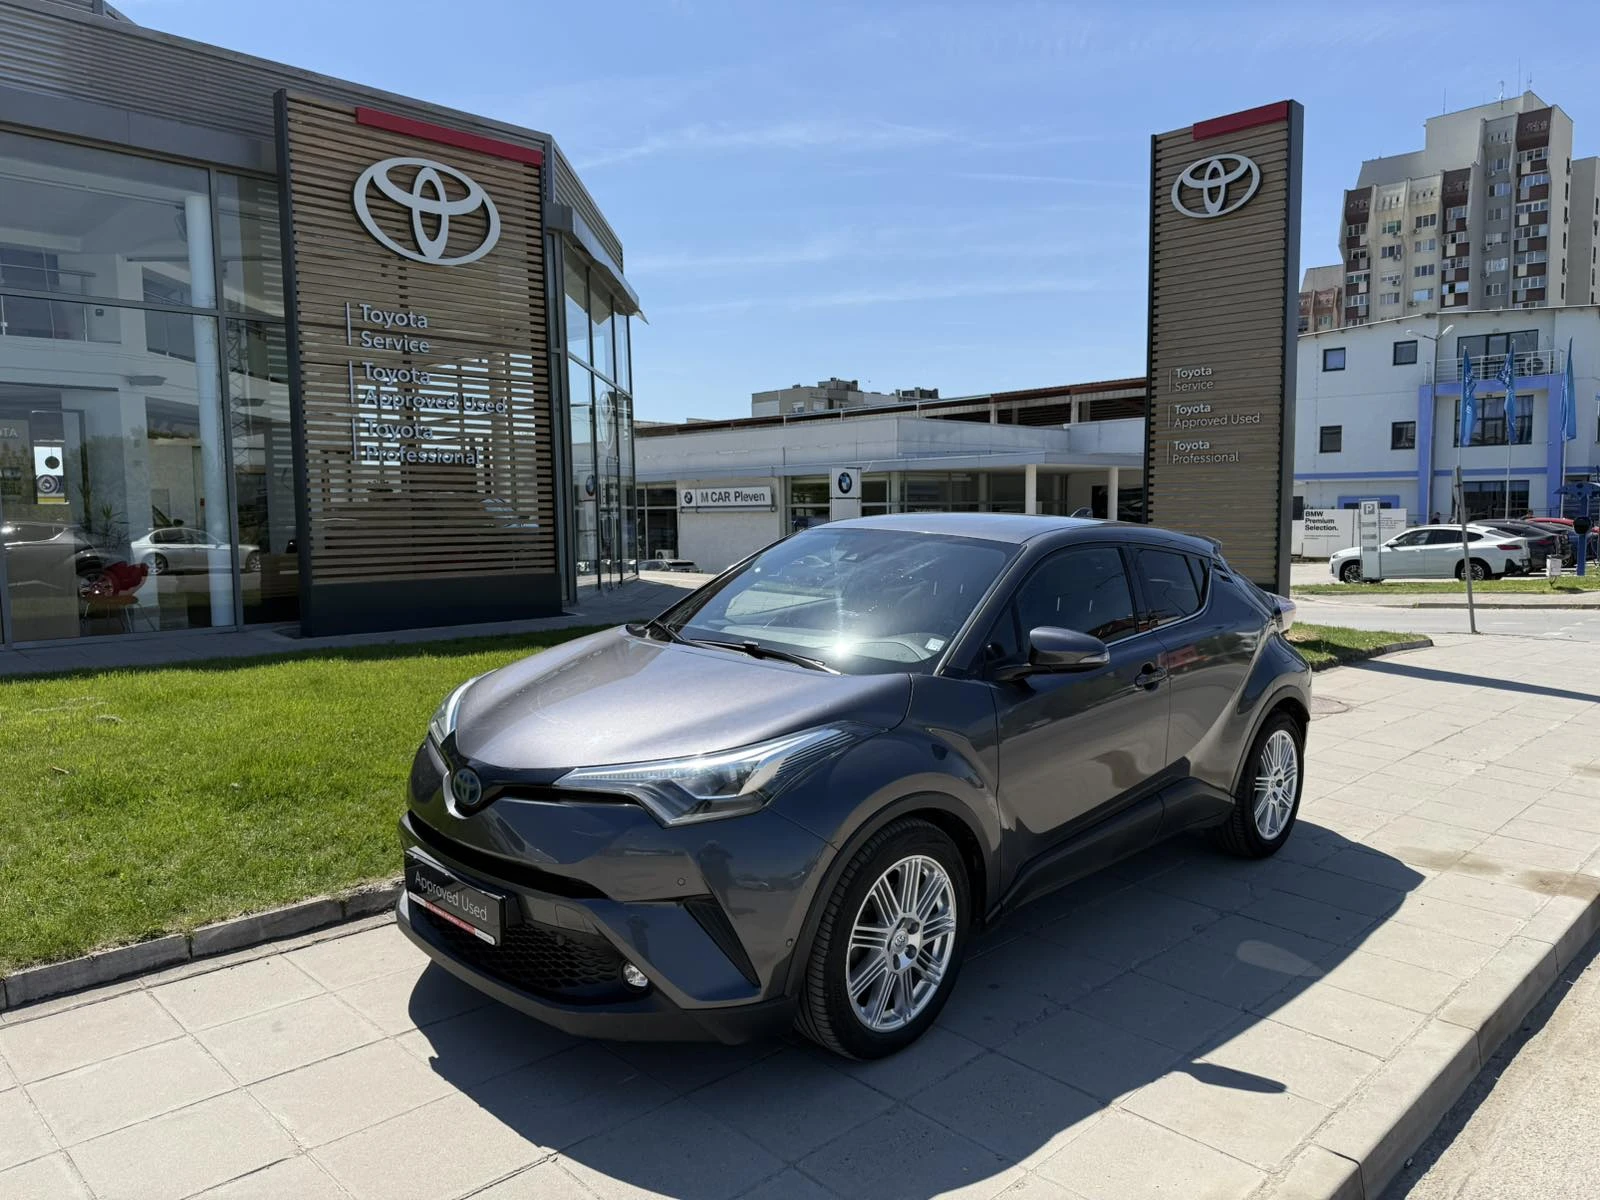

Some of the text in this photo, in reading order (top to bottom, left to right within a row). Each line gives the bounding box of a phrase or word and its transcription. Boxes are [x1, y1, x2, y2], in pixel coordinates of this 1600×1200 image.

[359, 303, 428, 329] Toyota
[360, 330, 430, 353] Service
[361, 361, 431, 386] Toyota
[1175, 366, 1212, 380] Toyota
[1175, 380, 1214, 392] Service
[363, 389, 507, 415] Approved Used
[1175, 403, 1211, 416] Toyota
[364, 418, 433, 440] Toyota
[1174, 412, 1261, 430] Approved Used
[365, 445, 482, 466] Professional
[1173, 440, 1210, 453] Toyota
[1172, 451, 1240, 464] Professional
[710, 491, 731, 503] CAR
[734, 490, 766, 503] Pleven
[415, 871, 459, 907] Approved
[461, 895, 487, 921] Used
